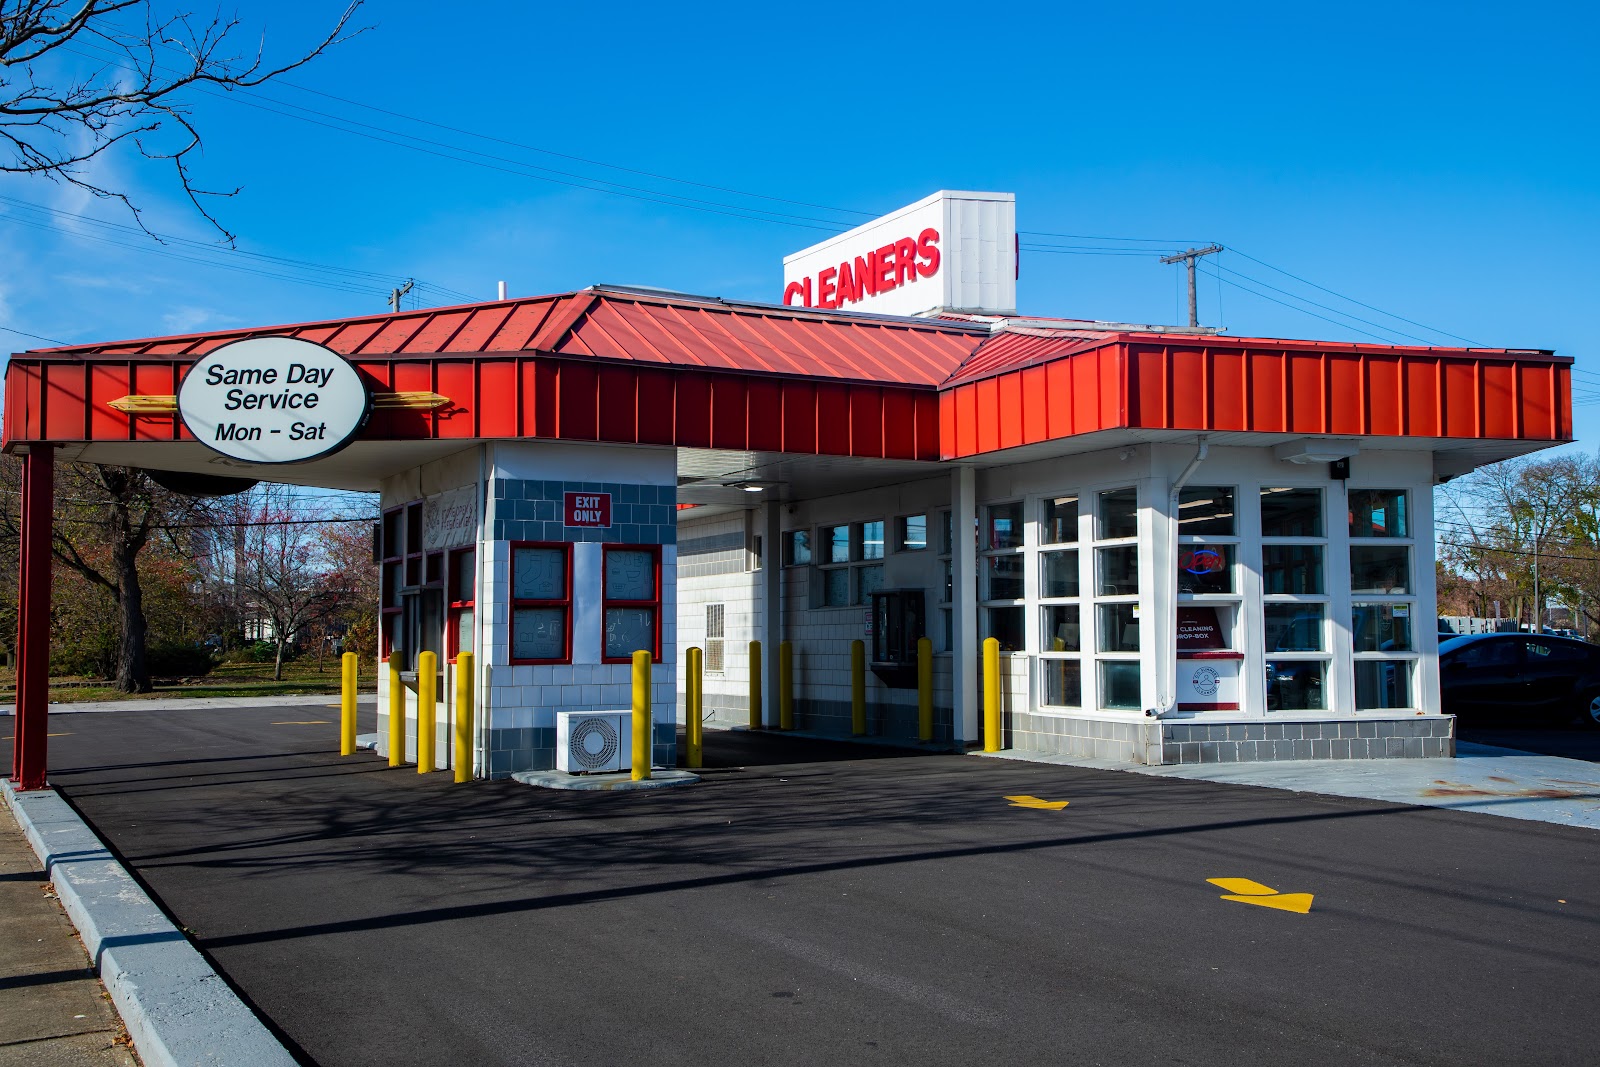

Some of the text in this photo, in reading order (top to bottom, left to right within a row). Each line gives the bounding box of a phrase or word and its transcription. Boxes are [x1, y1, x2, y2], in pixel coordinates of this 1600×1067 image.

[783, 227, 941, 309] CLEANERS
[205, 363, 335, 388] Same Day
[224, 388, 320, 411] Service
[214, 422, 262, 441] Mon
[288, 421, 327, 441] Sat
[575, 496, 601, 509] EXIT
[573, 509, 602, 523] ONLY
[1179, 551, 1223, 570] Open
